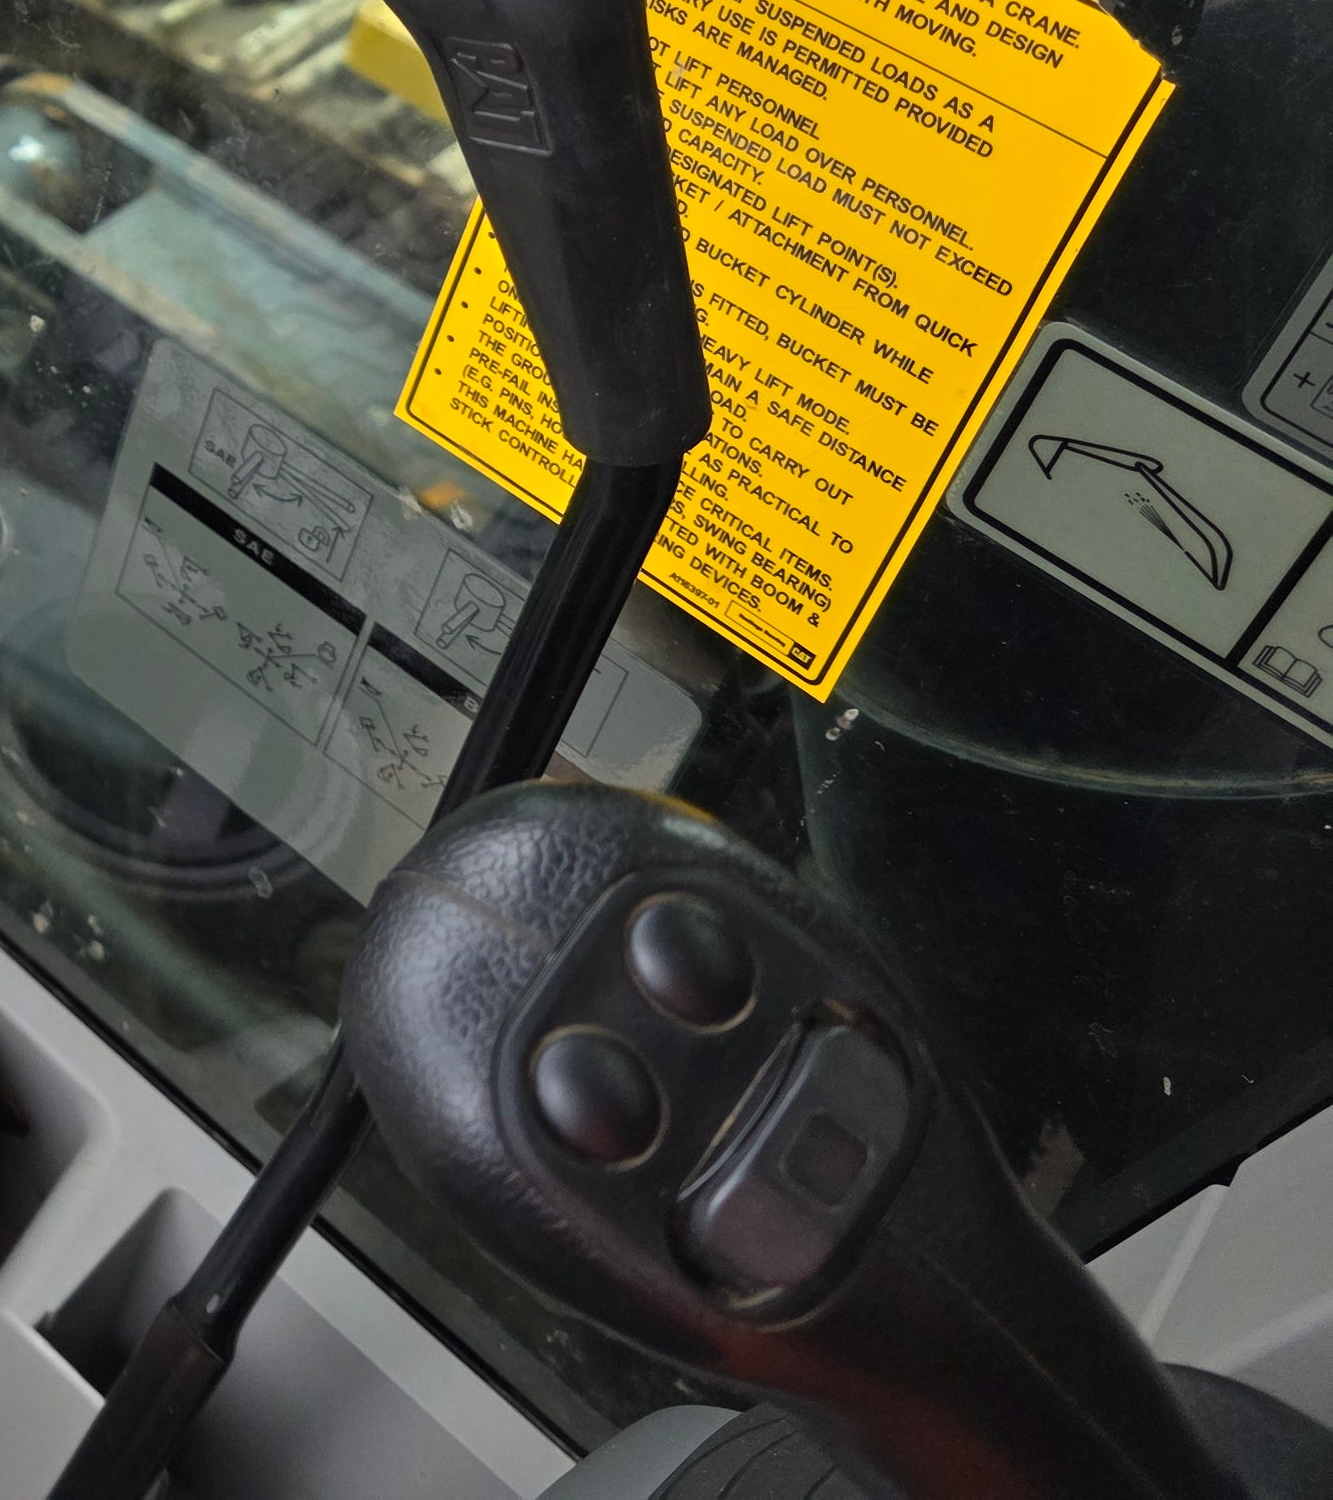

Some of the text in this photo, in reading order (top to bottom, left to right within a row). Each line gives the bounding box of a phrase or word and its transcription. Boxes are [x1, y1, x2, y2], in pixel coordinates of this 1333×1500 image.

[692, 20, 733, 50] ARE
[736, 41, 828, 101] MANAGED.
[894, 4, 976, 57] MOVING.
[985, 20, 1064, 69] DESIGN
[1004, 0, 1080, 49] CRANE.
[648, 36, 820, 141] OT LIFT PERSONNEL
[718, 5, 755, 35] USE
[760, 26, 779, 47] IS
[782, 39, 890, 103] PERMITTED
[894, 96, 993, 158] PROVIDED
[870, 56, 939, 101] LOADS
[942, 96, 974, 119] AS
[978, 114, 994, 133] A
[665, 71, 973, 252] LIFT ANY LOAD OVER PERSONNEL.
[670, 99, 772, 163] SUSPENDED
[776, 157, 827, 194] LOAD
[832, 187, 886, 225] MUST
[889, 219, 932, 250] NOT
[934, 244, 1013, 296] EXCEED
[678, 128, 765, 185] CAPACITY.
[669, 148, 898, 289] ESIGNATED LIFT POINT(S).
[695, 237, 934, 385] BUCKET CYLINDER WHILE
[728, 208, 850, 282] ATTACHMENT
[852, 277, 910, 319] FROM
[915, 313, 978, 358] QUICK
[479, 329, 507, 357] THE
[708, 292, 769, 341] FITTED,
[776, 332, 852, 383] BUCKET
[854, 379, 908, 416] MUST
[910, 411, 939, 437] BE
[482, 313, 540, 357] POSITIO
[698, 453, 723, 473] AS
[727, 468, 821, 537] PRACTICAL
[830, 531, 854, 555] TO
[710, 390, 747, 423] OAD.
[745, 389, 759, 405] A
[767, 400, 815, 436] SAFE
[817, 431, 907, 493] DISTANCE
[754, 368, 794, 397] LIFT
[796, 393, 850, 435] MODE.
[450, 397, 762, 613] STICK CONTROLL DEVICES.
[458, 381, 489, 409] THIS
[493, 405, 559, 454] MACHINE
[561, 449, 583, 471] HA
[705, 543, 748, 579] WITH
[750, 574, 804, 615] BOOM
[807, 612, 820, 628] &
[462, 363, 493, 392] (E.G.
[500, 387, 534, 421] PINS,
[693, 513, 746, 556] SWING
[750, 551, 832, 613] BEARING)
[469, 347, 532, 396] PRE-FAIL
[700, 497, 772, 553] CRITICAL
[779, 547, 833, 592] ITEMS.
[703, 431, 763, 478] ATIONS.
[722, 417, 743, 440] TO
[749, 437, 810, 480] CARRY
[814, 477, 854, 505] OUT
